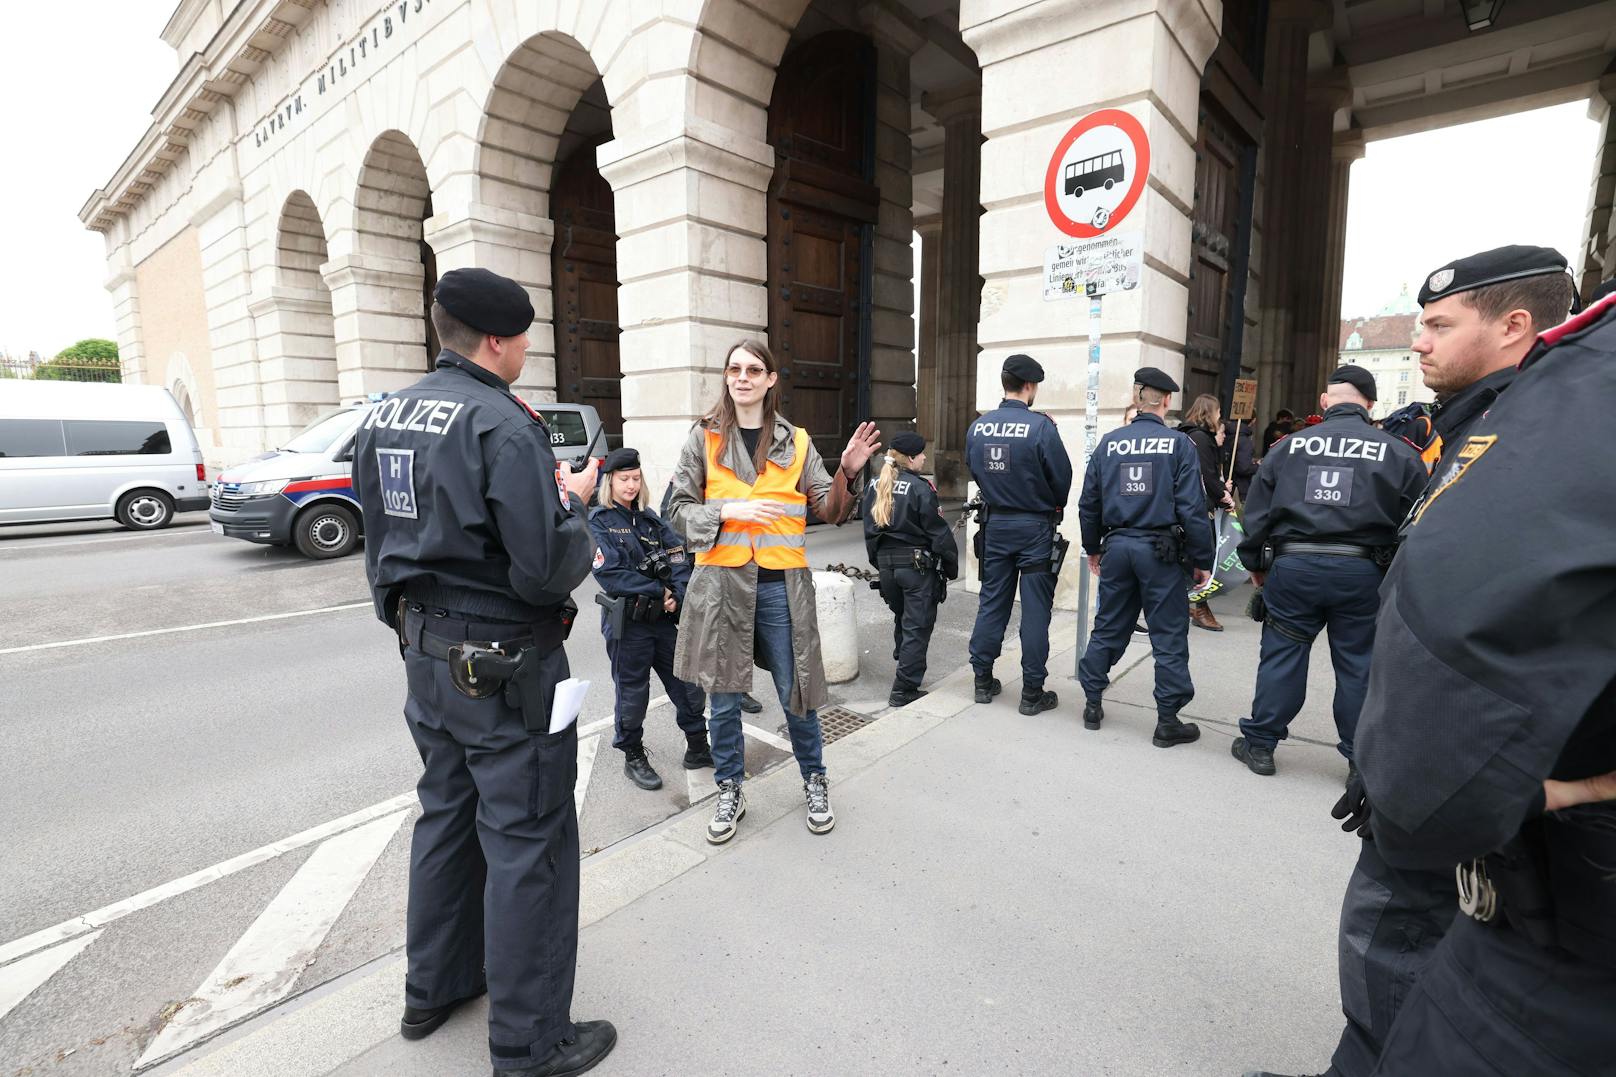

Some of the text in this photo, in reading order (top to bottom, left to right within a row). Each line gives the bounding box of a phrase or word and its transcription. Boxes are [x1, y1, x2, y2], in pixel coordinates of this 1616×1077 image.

[363, 397, 465, 436] POLIZEI
[973, 422, 1030, 438] POLIZEI
[990, 447, 1002, 461] U
[1106, 437, 1176, 457] POLIZEI
[1288, 436, 1388, 462] POLIZEI
[389, 455, 402, 479] H
[988, 461, 1005, 471] 330
[1129, 466, 1143, 481] U
[1126, 482, 1146, 492] 330
[1320, 470, 1340, 488] U
[385, 489, 412, 512] 102
[1313, 489, 1342, 501] 330
